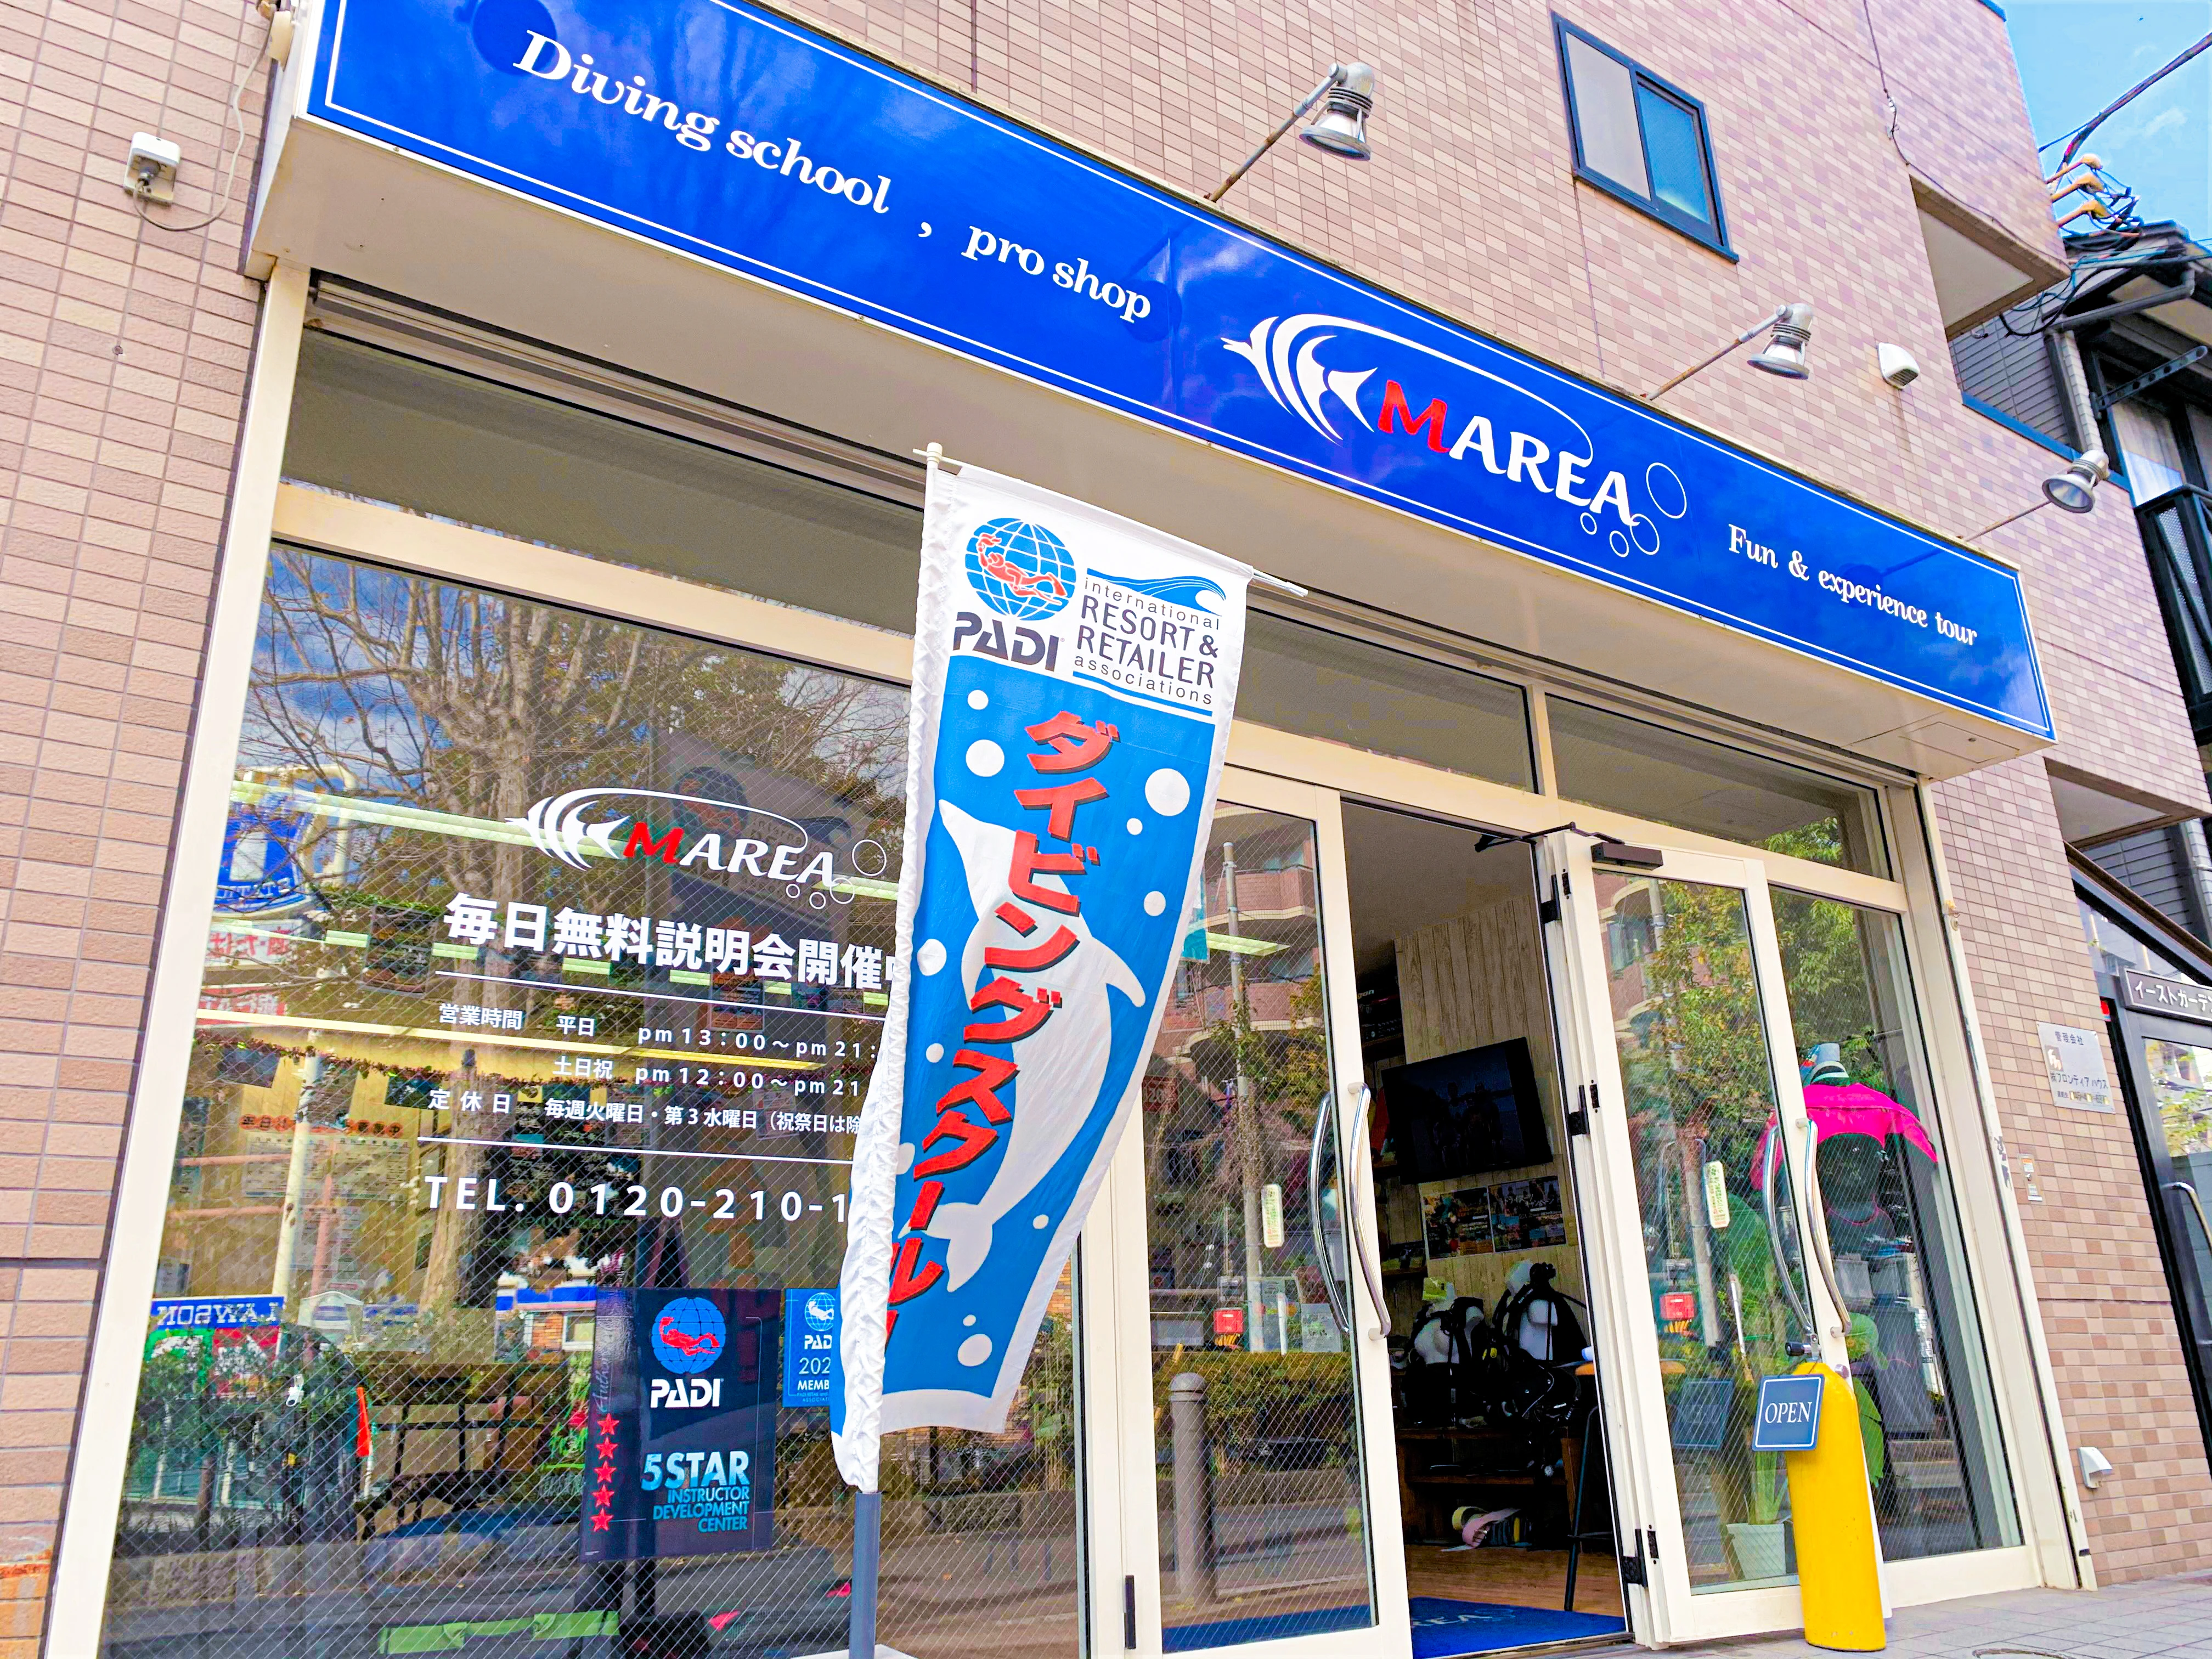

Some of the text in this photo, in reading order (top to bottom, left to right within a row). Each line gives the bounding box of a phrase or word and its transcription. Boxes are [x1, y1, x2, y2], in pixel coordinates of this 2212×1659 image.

[513, 30, 720, 152] Diving
[726, 131, 891, 214] school
[961, 225, 1045, 275] pro
[1053, 257, 1151, 324] shop
[1378, 380, 1640, 526] MAREA
[1085, 577, 1219, 630] international
[1728, 523, 1978, 646] Fun & experience tour
[953, 611, 1059, 673] PADI
[1081, 595, 1218, 658] RESORT &
[1074, 655, 1212, 705] associations
[1076, 625, 1214, 689] RETAILER
[624, 822, 842, 887] MAREA
[439, 1003, 523, 1031] 営業時間
[556, 1015, 595, 1037] 平日
[552, 1056, 613, 1080] 土日祝
[424, 1176, 524, 1212] TEL.
[651, 1378, 720, 1408] PADI
[1765, 1402, 1813, 1424] OPEN
[653, 1500, 750, 1520] DEVELOPMENT
[667, 1486, 749, 1502] INSTRUCTOR
[697, 1516, 748, 1532] CENTER
